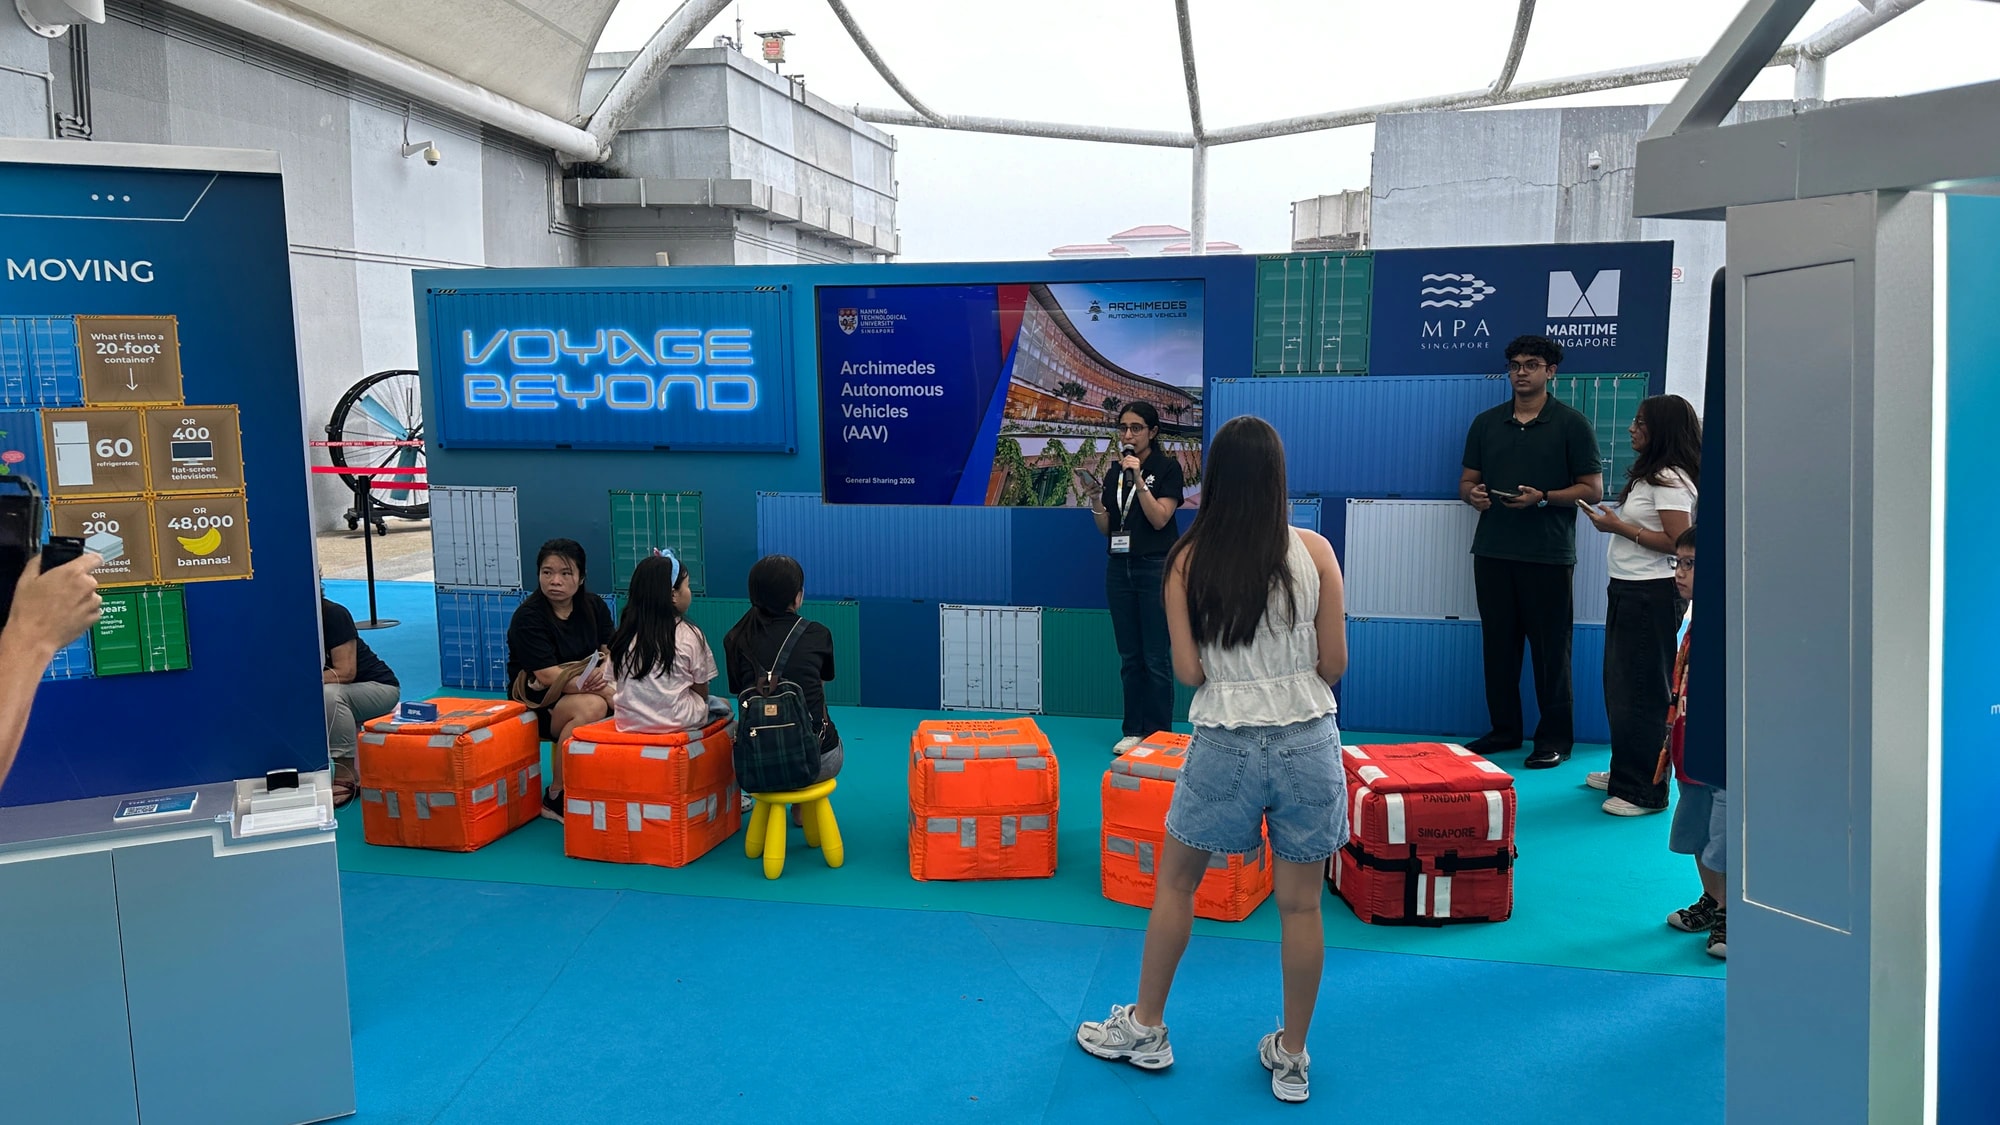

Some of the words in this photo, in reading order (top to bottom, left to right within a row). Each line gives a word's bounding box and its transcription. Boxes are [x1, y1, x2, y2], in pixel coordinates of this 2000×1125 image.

[6, 258, 154, 283] MOVING
[1108, 301, 1188, 311] ARCHIMEDES
[1421, 319, 1491, 338] MPA
[1545, 323, 1618, 337] MARITIME
[137, 332, 157, 340] into
[96, 342, 162, 354] 20-foot
[462, 328, 754, 366] VOYAGE
[1420, 341, 1490, 350] SINGAPORE
[104, 356, 155, 364] container?
[840, 360, 936, 375] Archimedes
[462, 373, 757, 410] BEYOND
[841, 382, 944, 397] Autonomous
[841, 403, 909, 418] Vehicles
[172, 427, 210, 440] 400
[843, 425, 889, 443] (AAV)
[95, 438, 133, 458] 60
[171, 466, 217, 474] flat-screen
[872, 477, 898, 485] Sharing
[82, 520, 120, 535] 200
[167, 515, 234, 531] 48,000
[177, 555, 231, 567] bananas!
[99, 605, 128, 615] years
[1422, 793, 1471, 803] PANDUAN
[1417, 826, 1477, 839] SINGAPORE
